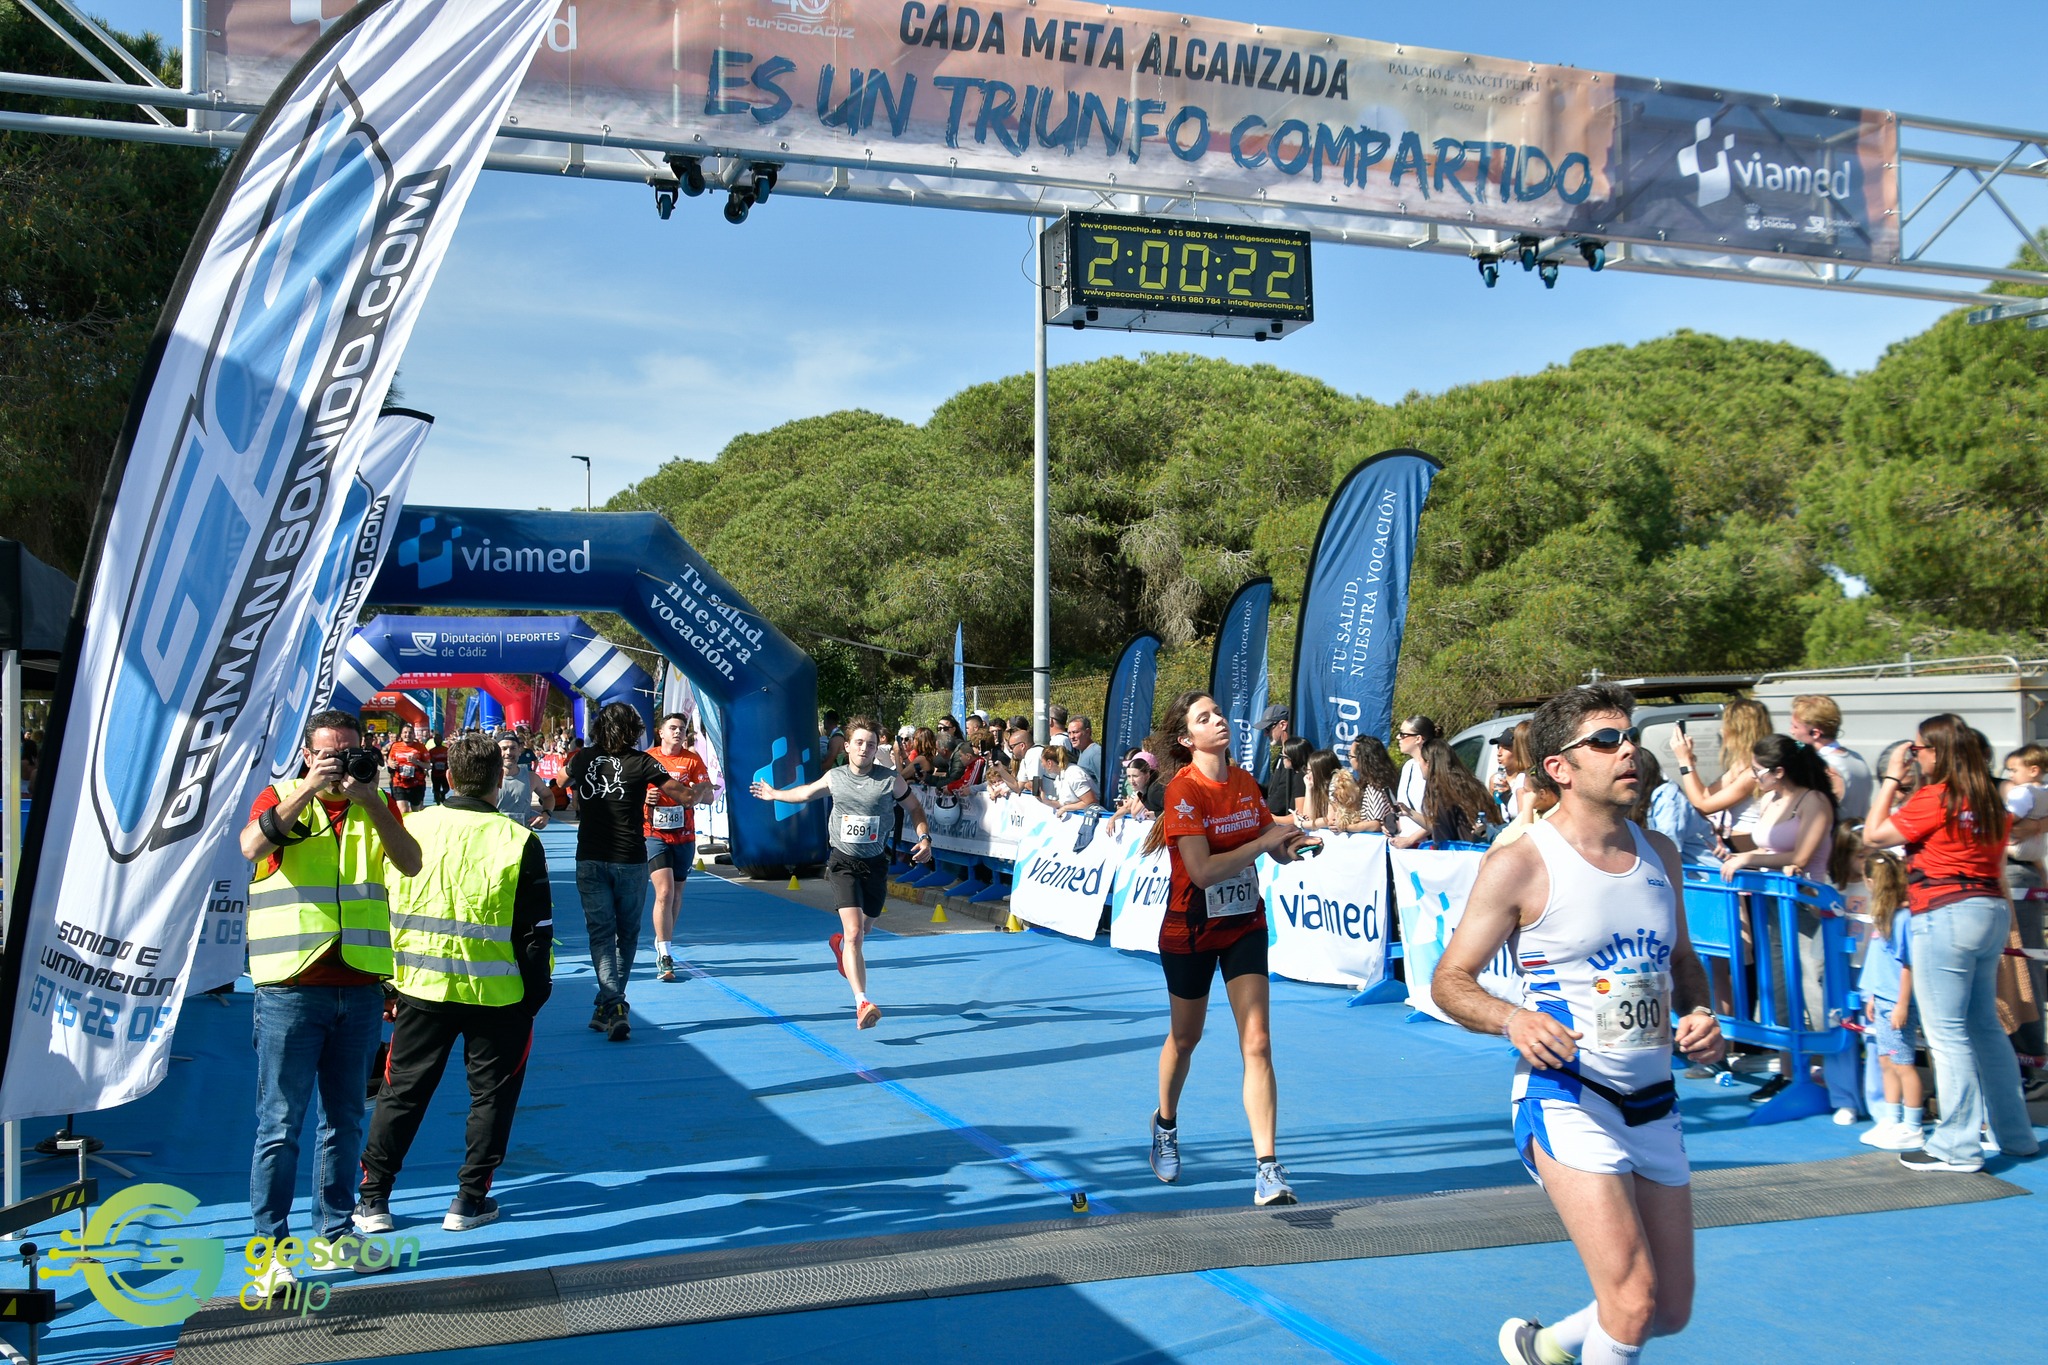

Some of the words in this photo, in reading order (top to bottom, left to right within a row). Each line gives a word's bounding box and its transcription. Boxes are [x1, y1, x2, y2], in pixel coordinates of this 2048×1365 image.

[900, 1, 1005, 54] CADA
[1022, 17, 1124, 70] META
[1137, 33, 1348, 100] ALCANZADA
[1388, 63, 1441, 79] PALACIO
[1444, 70, 1455, 81] de
[1458, 73, 1502, 88] SANCTI
[1506, 79, 1540, 92] PETRI
[704, 49, 797, 127] ES
[817, 63, 917, 138] UN
[934, 76, 1210, 164] TRIUNFO
[1230, 114, 1593, 205] COMPARTIDO
[1733, 152, 1851, 200] viamed
[1080, 222, 1161, 235] www.gesconchip.es
[1168, 229, 1183, 237] 615
[1186, 230, 1201, 238] 980
[1203, 231, 1218, 239] 784
[1224, 233, 1301, 246] info@gesconchip.es
[1087, 236, 1296, 299] 2:00:22
[1083, 289, 1164, 303] www.gesconchip.es
[1171, 295, 1186, 303] 615
[1189, 296, 1204, 304] 980
[1206, 297, 1221, 305] 784
[1227, 298, 1305, 311] info@gesconchip.es
[461, 538, 590, 574] viamed
[1350, 590, 1378, 677] NUESTRA
[1366, 488, 1397, 584] VOCACIÓN
[665, 581, 752, 664] nuestra
[680, 563, 708, 596] Tu
[706, 593, 764, 652] salud,
[1337, 576, 1362, 643] SALUD,
[441, 632, 497, 645] Diputación
[506, 632, 560, 643] DEPORTES
[441, 647, 455, 657] de
[458, 645, 487, 657] Cádiz
[650, 594, 735, 681] vocación.
[1331, 649, 1347, 673] TU
[658, 813, 679, 823] 2148
[846, 824, 872, 836] 2691
[215, 880, 231, 892] E
[1028, 852, 1106, 896] viamed
[1216, 882, 1251, 904] 1767
[215, 919, 243, 945] 09
[1280, 881, 1379, 942] viamed
[57, 920, 133, 960] SONIDO
[135, 946, 162, 967] E
[1586, 928, 1670, 971] white
[82, 996, 121, 1039] 22
[1619, 998, 1660, 1030] 300
